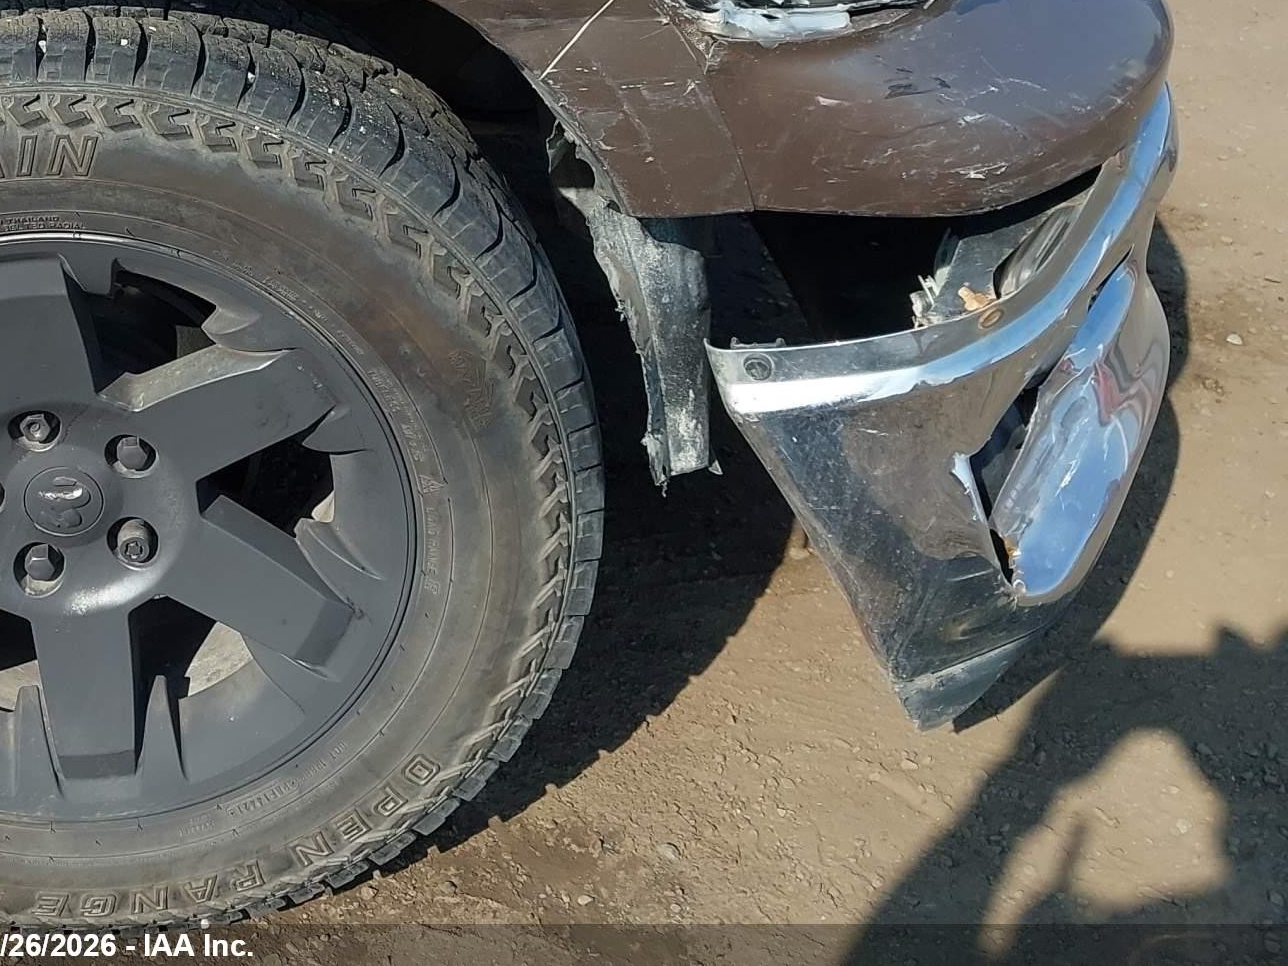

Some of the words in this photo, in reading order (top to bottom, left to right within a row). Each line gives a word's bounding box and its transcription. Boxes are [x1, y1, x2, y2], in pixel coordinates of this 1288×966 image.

[6, 215, 60, 225] THAILAND
[292, 754, 441, 868] OPEN
[32, 860, 266, 918] RANGE
